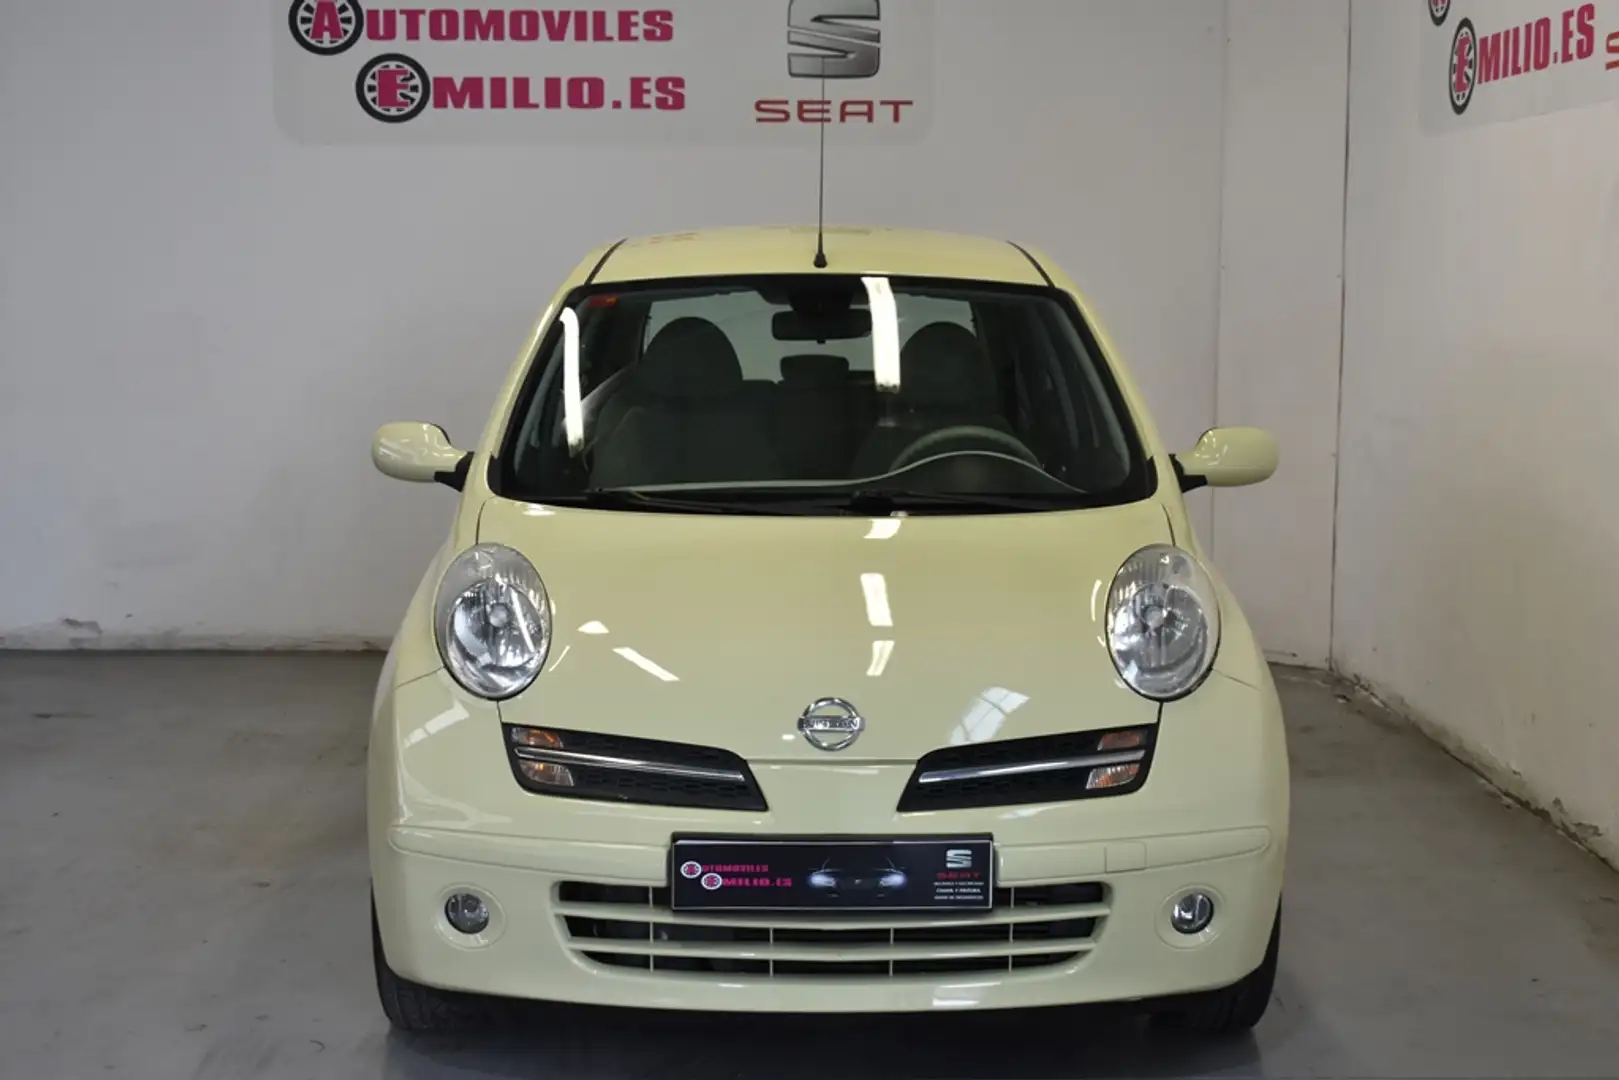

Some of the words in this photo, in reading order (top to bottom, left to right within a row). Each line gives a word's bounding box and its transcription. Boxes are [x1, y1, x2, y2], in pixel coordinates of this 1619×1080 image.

[309, 0, 674, 42] AUTOMOVILES
[1455, 3, 1596, 93] EMILIO.ES
[376, 69, 686, 111] EMILIO.ES
[755, 100, 914, 124] SEAT
